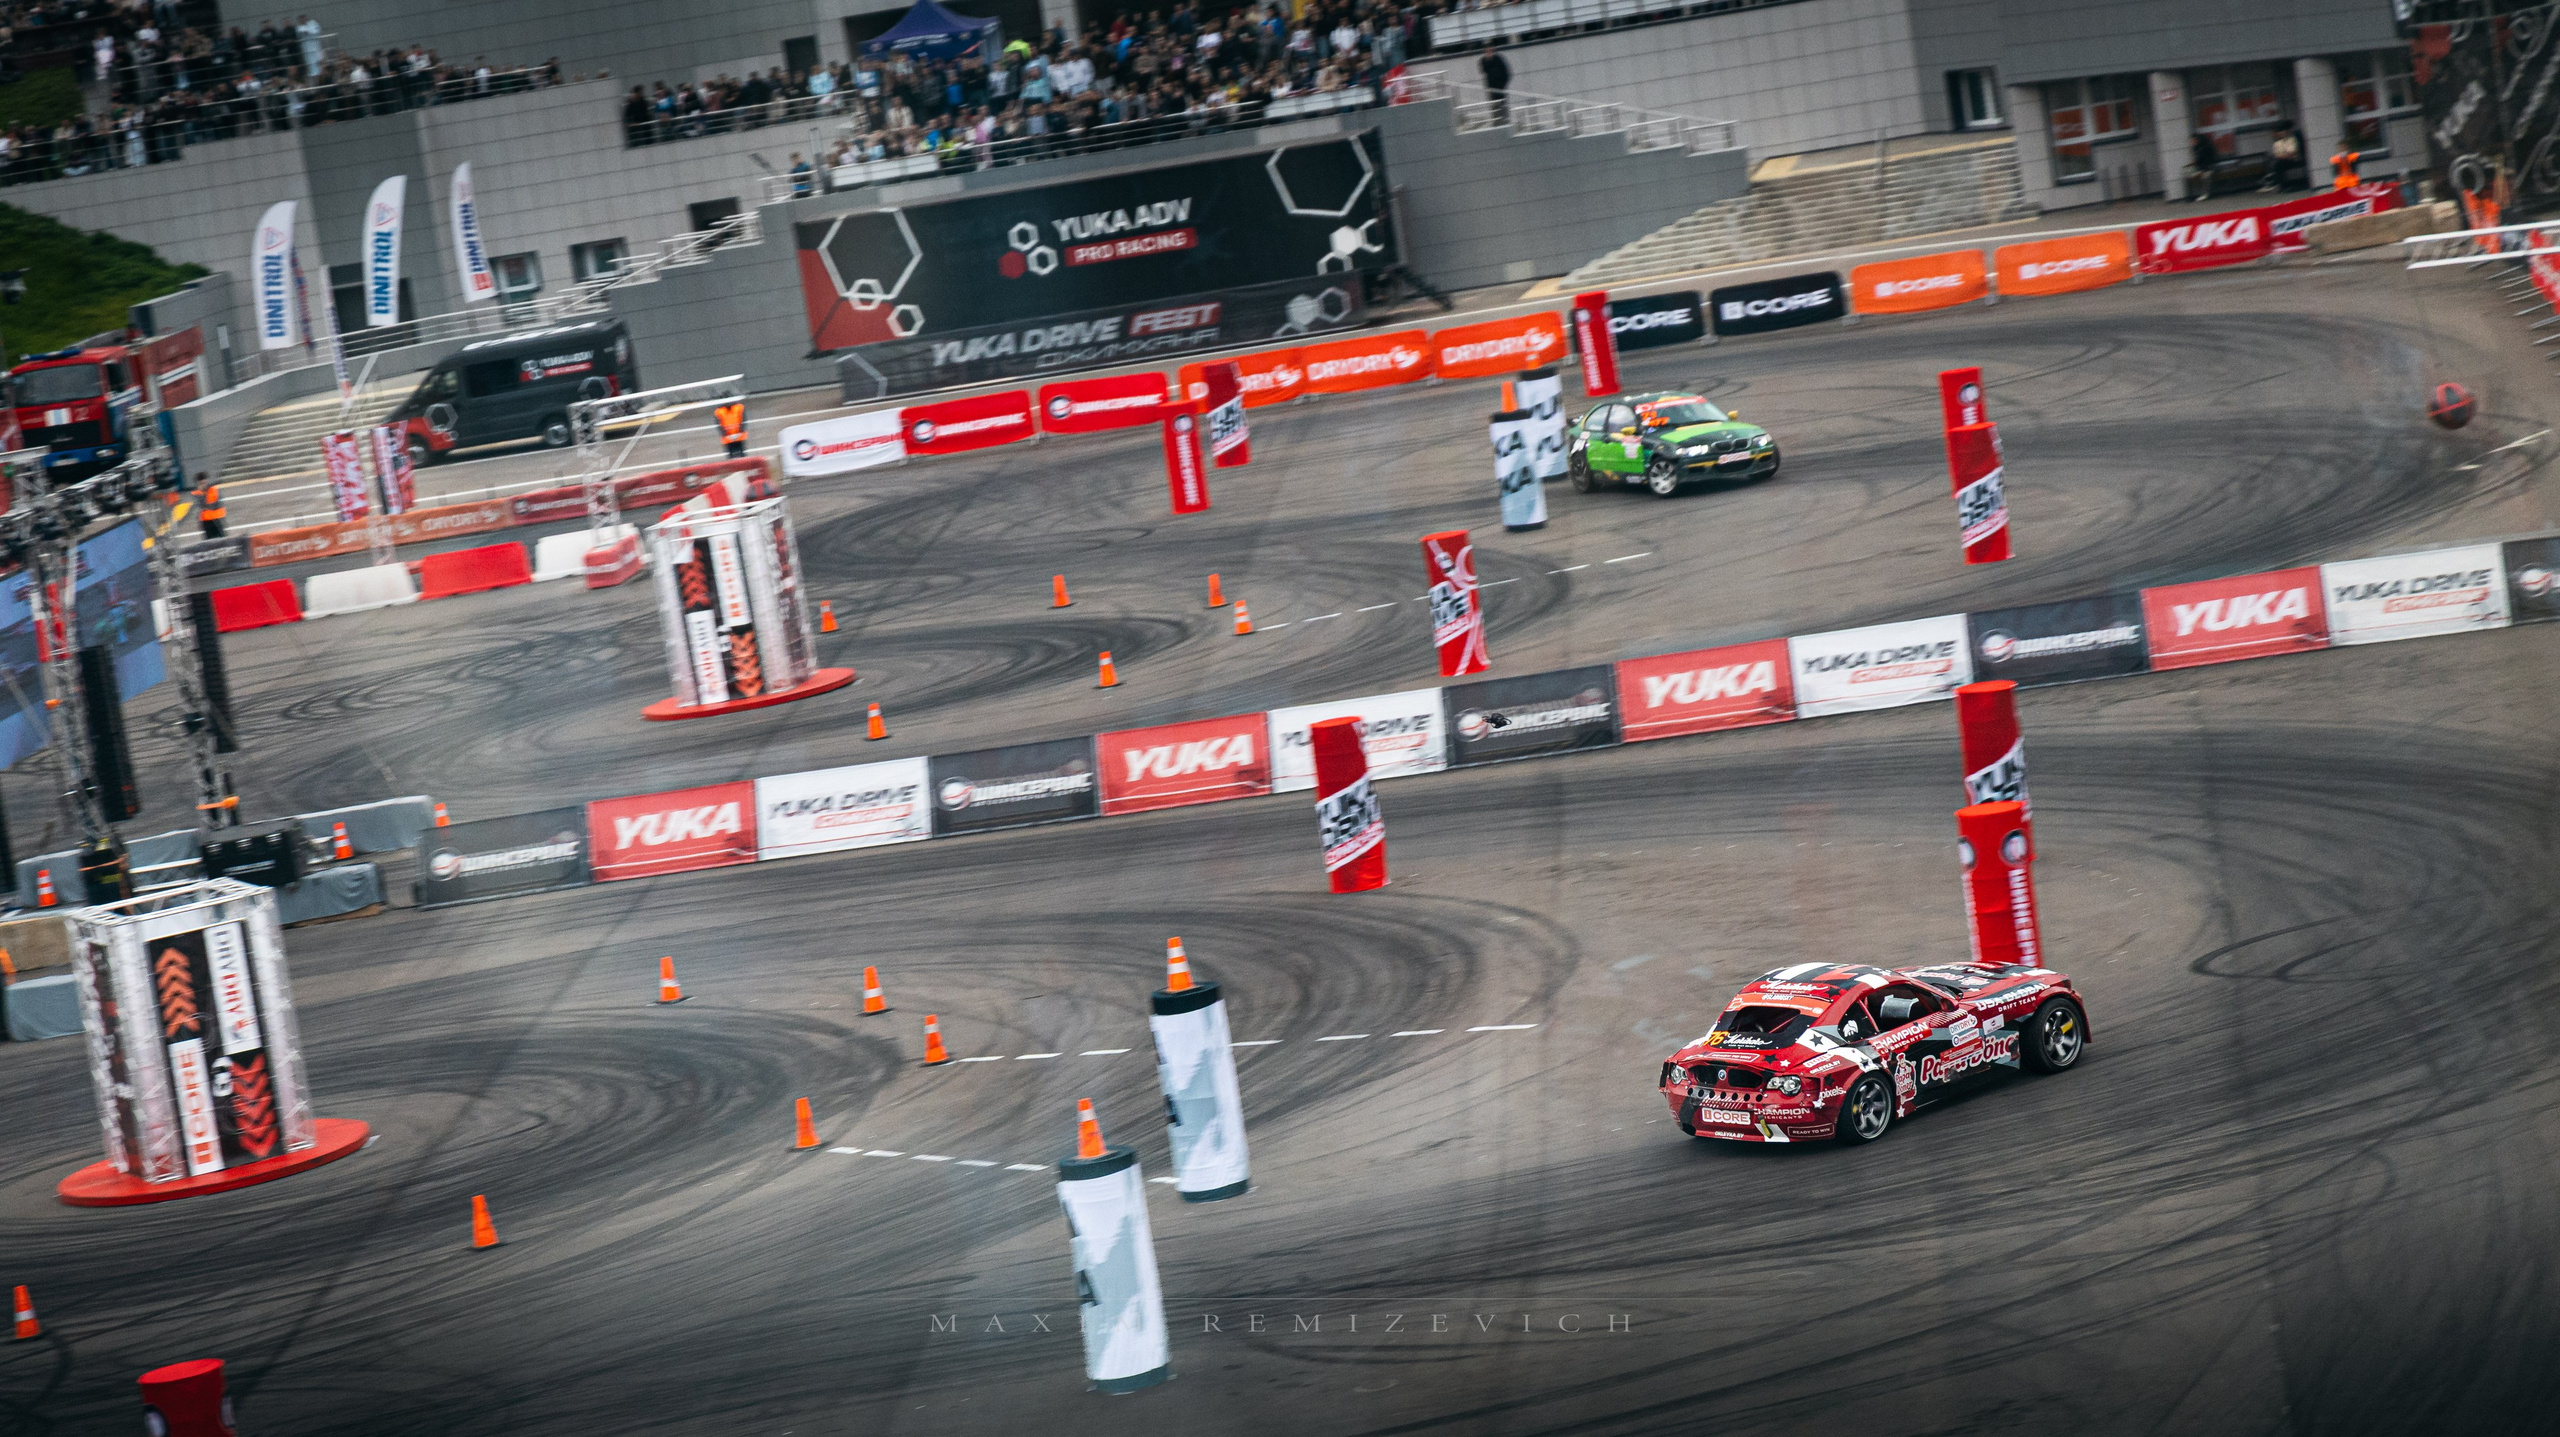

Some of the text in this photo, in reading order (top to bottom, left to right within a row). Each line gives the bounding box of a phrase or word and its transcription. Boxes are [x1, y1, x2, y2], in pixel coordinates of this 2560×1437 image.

[2150, 215, 2261, 256] YUKA
[372, 230, 392, 315] DINITROL
[261, 253, 286, 338] DINITROL
[930, 302, 1222, 367] YUKA DRIVE FEST
[2408, 567, 2494, 595] DRIVE
[2172, 587, 2309, 637] YUKA
[1875, 639, 1958, 666] DRIVE
[1644, 660, 1778, 708] YUKA
[1124, 733, 1254, 783] YUKA
[838, 783, 919, 811] DRIVE
[613, 801, 742, 850] YUKA
[1998, 996, 2037, 1013] DRIFT TEAM
[1703, 1031, 1729, 1046] 76
[1872, 1021, 1929, 1050] CHAMPION
[1949, 1020, 1971, 1035] DRYDRY
[1753, 1107, 1810, 1115] CHAMPION
